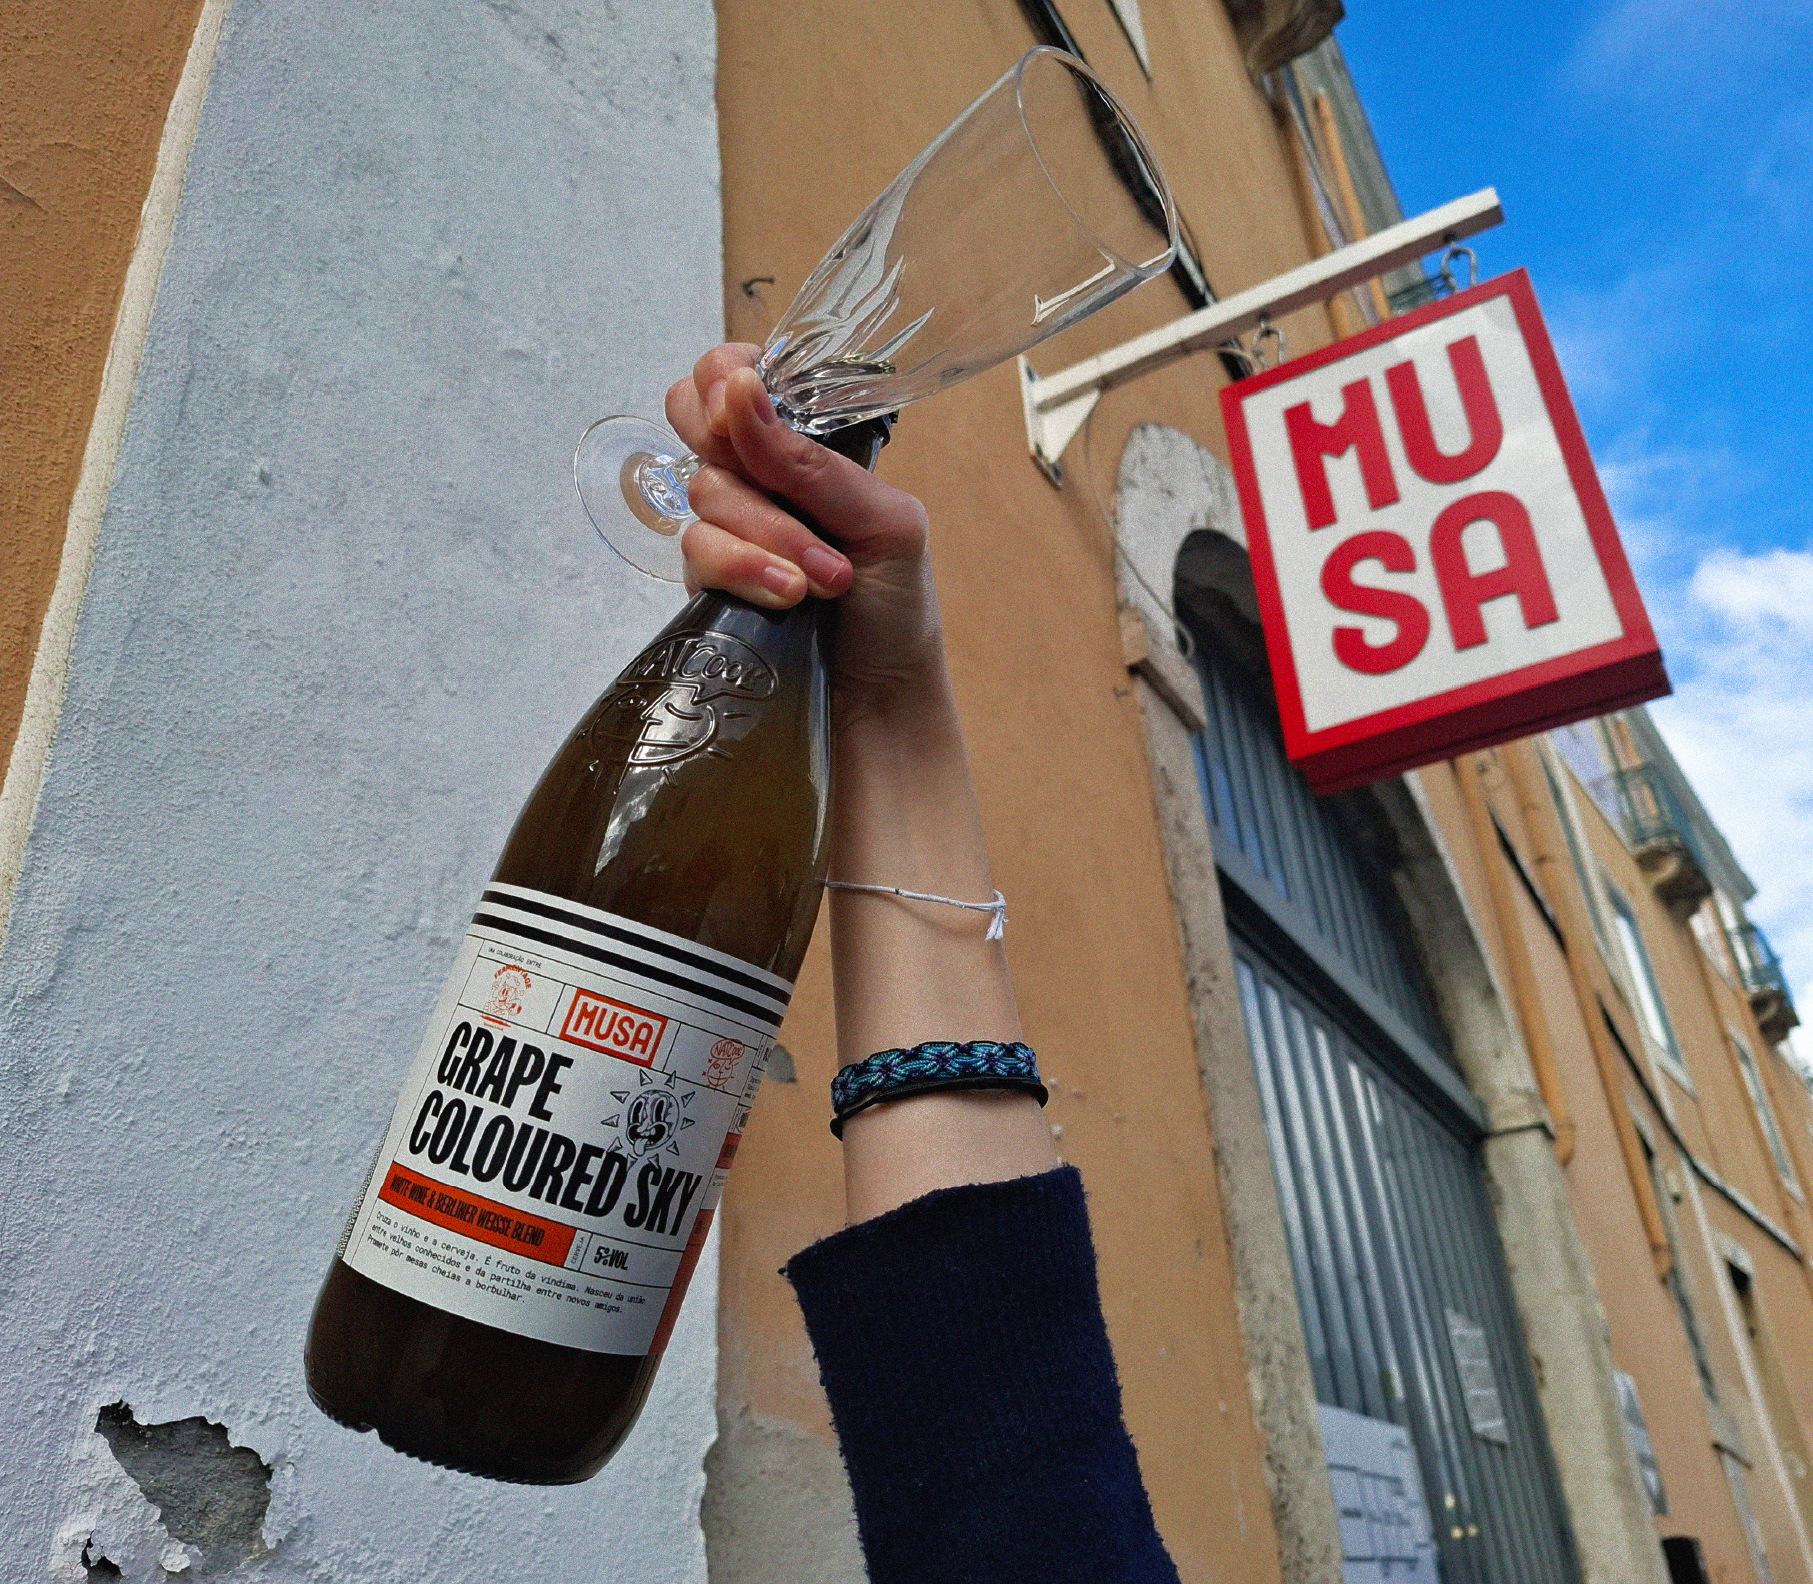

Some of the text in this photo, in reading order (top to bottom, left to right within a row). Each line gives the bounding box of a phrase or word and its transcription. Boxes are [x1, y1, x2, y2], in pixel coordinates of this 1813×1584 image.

[1284, 335, 1502, 531] MU
[1320, 490, 1560, 675] SA
[496, 949, 525, 963] COLABORAÇÃO
[526, 958, 543, 969] ENTRE
[573, 1001, 655, 1055] MUSA
[437, 1021, 574, 1122] GRAPE
[409, 1089, 703, 1237] COLOURED SKY
[389, 1174, 546, 1247] WHITE WINE & BERLINER WEISSE BLEND
[571, 1236, 585, 1265] CERVEJA
[367, 1233, 390, 1252] Promete
[405, 1254, 428, 1269] mesas
[431, 1265, 461, 1281] cheias
[465, 1278, 471, 1286] a
[475, 1279, 526, 1303] borbulhar.
[372, 1224, 387, 1237] entre
[389, 1233, 412, 1249] velhos
[415, 1245, 461, 1268] conhecidos
[475, 1267, 486, 1277] da
[489, 1274, 532, 1292] partilha
[536, 1288, 562, 1300] entre
[566, 1295, 591, 1307] novos
[594, 1301, 623, 1313] amigos.
[393, 1221, 398, 1229] o
[401, 1224, 421, 1239] vinho
[441, 1242, 479, 1261] cerveja.
[484, 1254, 492, 1265] É
[496, 1259, 521, 1275] fruto
[525, 1269, 536, 1280] da
[541, 1275, 579, 1292] vindima.
[584, 1286, 613, 1299] Nasceu
[616, 1292, 624, 1302] da
